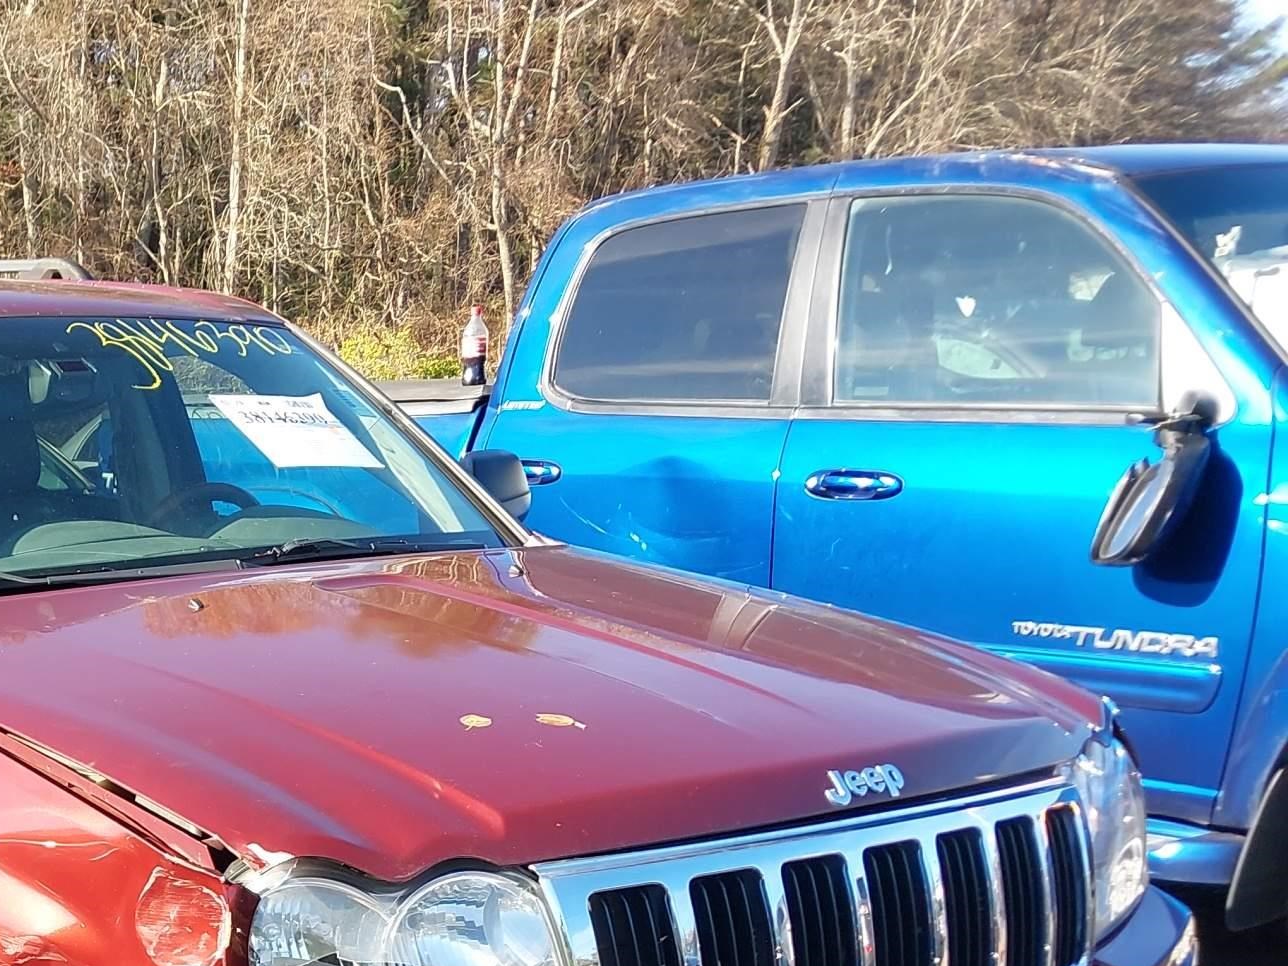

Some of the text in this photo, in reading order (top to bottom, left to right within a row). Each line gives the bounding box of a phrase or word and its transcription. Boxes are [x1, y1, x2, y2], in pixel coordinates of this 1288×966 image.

[1012, 620, 1219, 658] TOYOTA TUNDRA
[824, 763, 905, 806] Jeep
